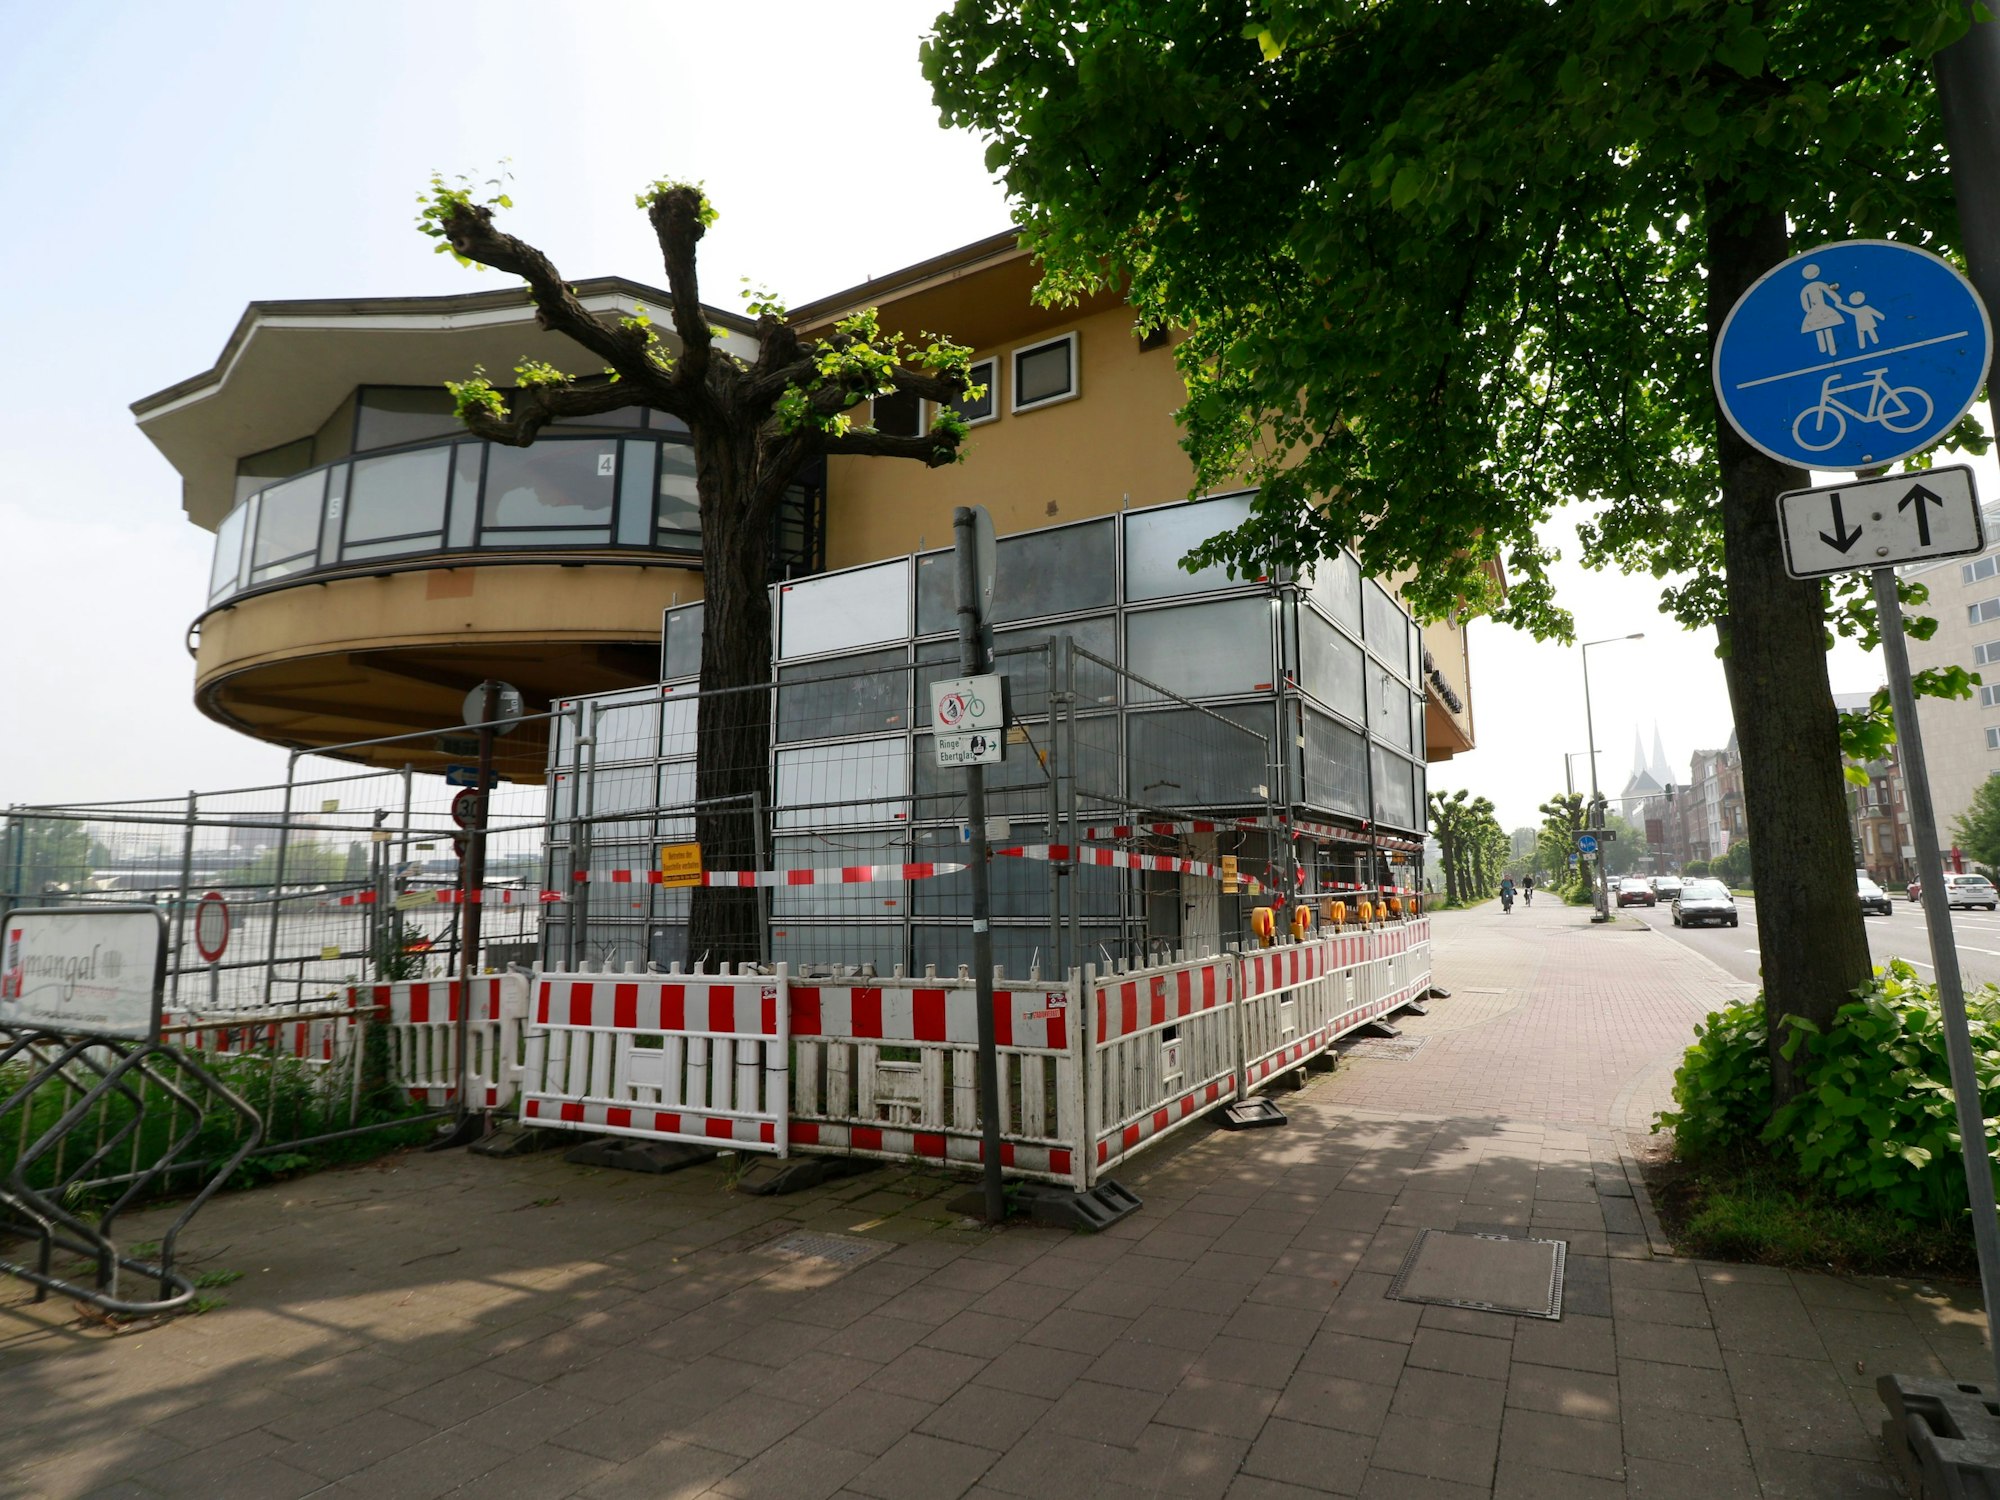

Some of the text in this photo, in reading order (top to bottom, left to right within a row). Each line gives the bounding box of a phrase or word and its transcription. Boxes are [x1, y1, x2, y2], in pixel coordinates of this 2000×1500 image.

[600, 456, 612, 473] 4
[939, 739, 960, 750] Ringe
[940, 750, 975, 762] Ebertplat
[25, 943, 101, 1002] mangal
